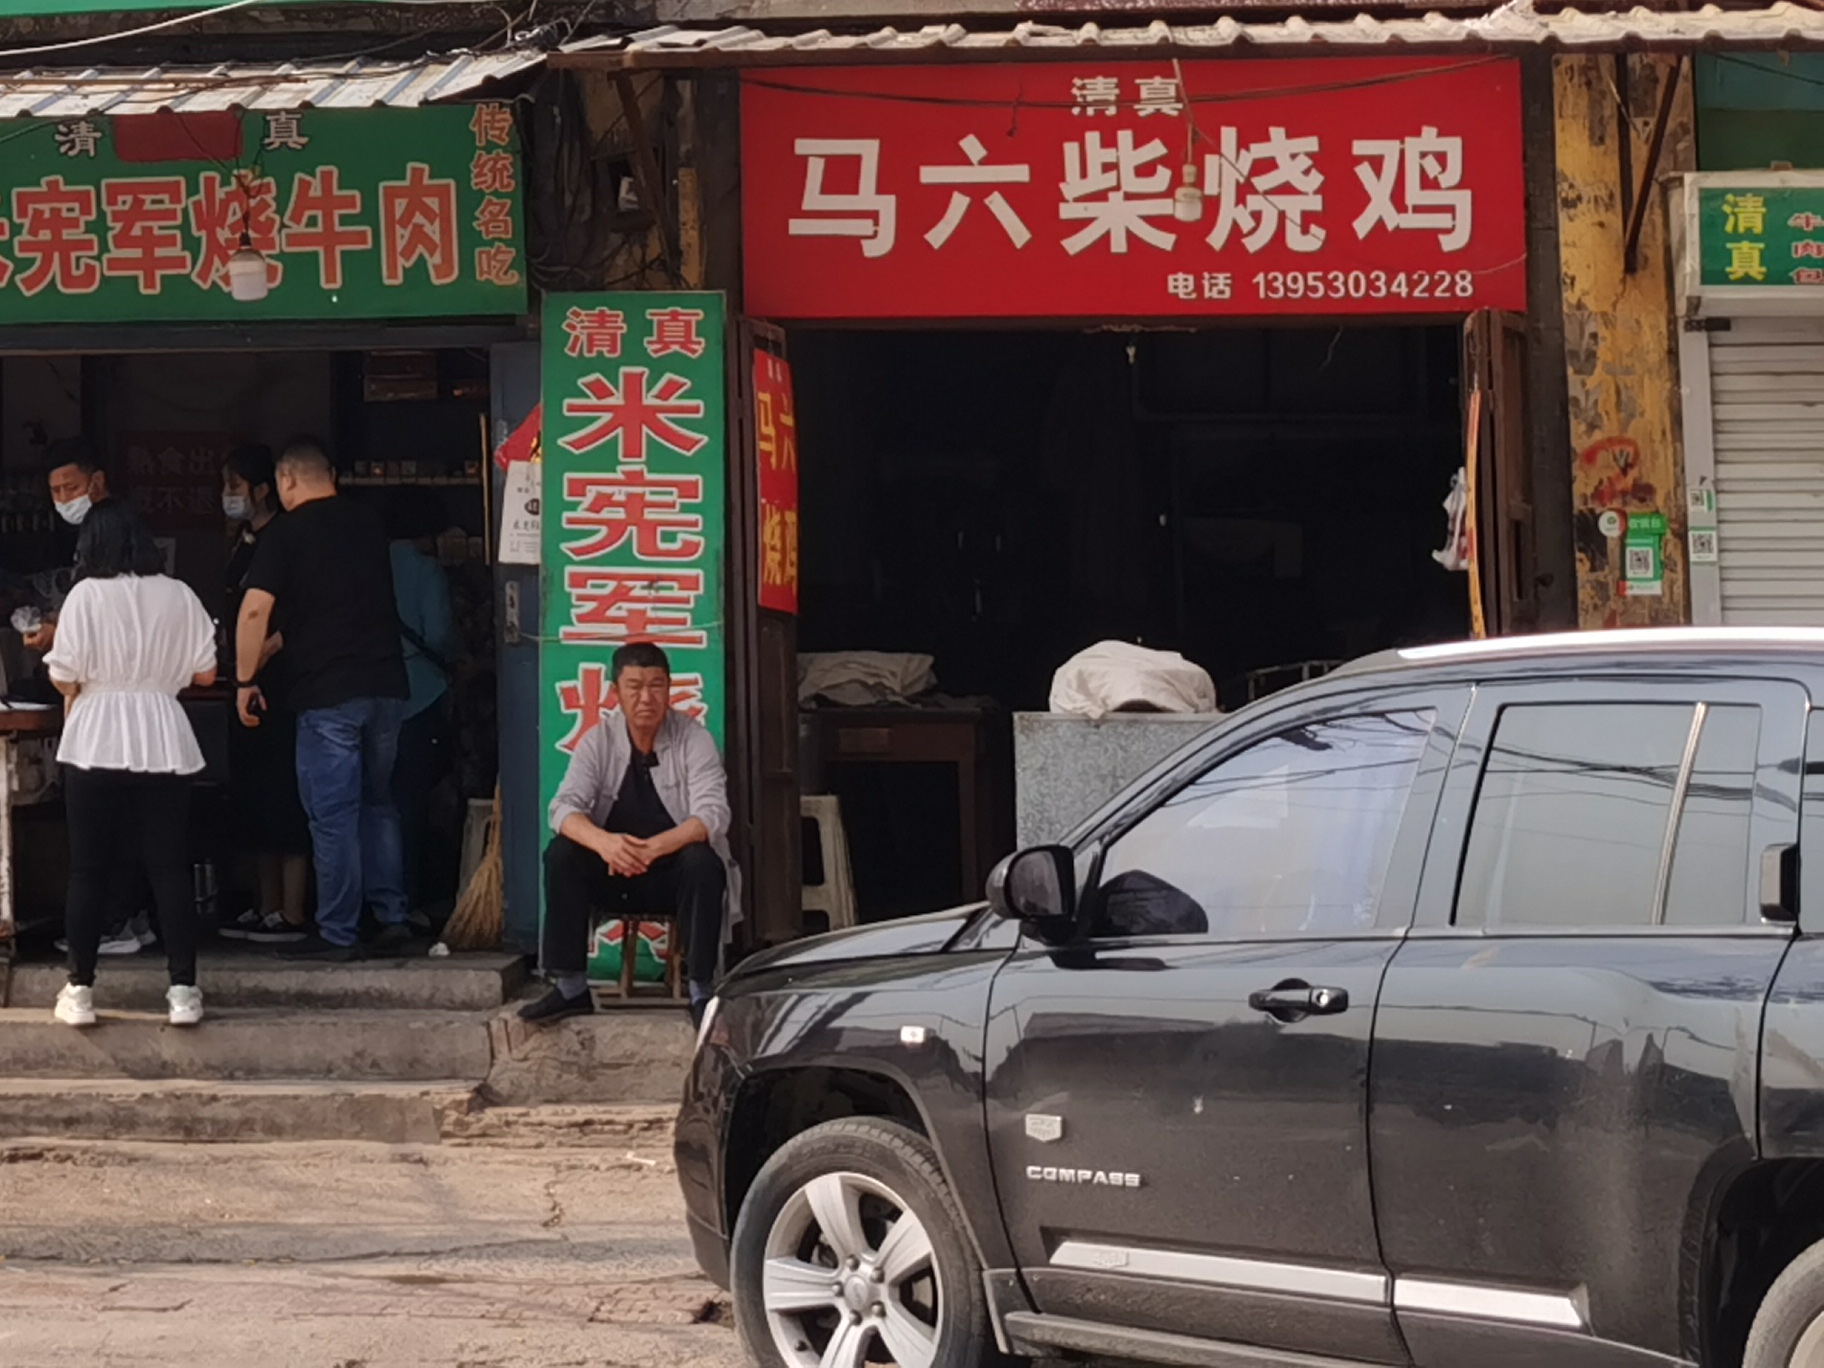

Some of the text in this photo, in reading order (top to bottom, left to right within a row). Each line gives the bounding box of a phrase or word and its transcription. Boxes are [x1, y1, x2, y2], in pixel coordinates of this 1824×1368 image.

[1070, 76, 1184, 117] 清真
[54, 111, 309, 159] 清 真
[470, 102, 520, 288] 传统名吃
[788, 126, 1474, 259] 马六柴烧鸡
[1722, 193, 1768, 282] 清真
[1166, 269, 1475, 301] 电话 13953034228
[562, 306, 705, 359] 清真
[1025, 1165, 1141, 1188] COMPASS
